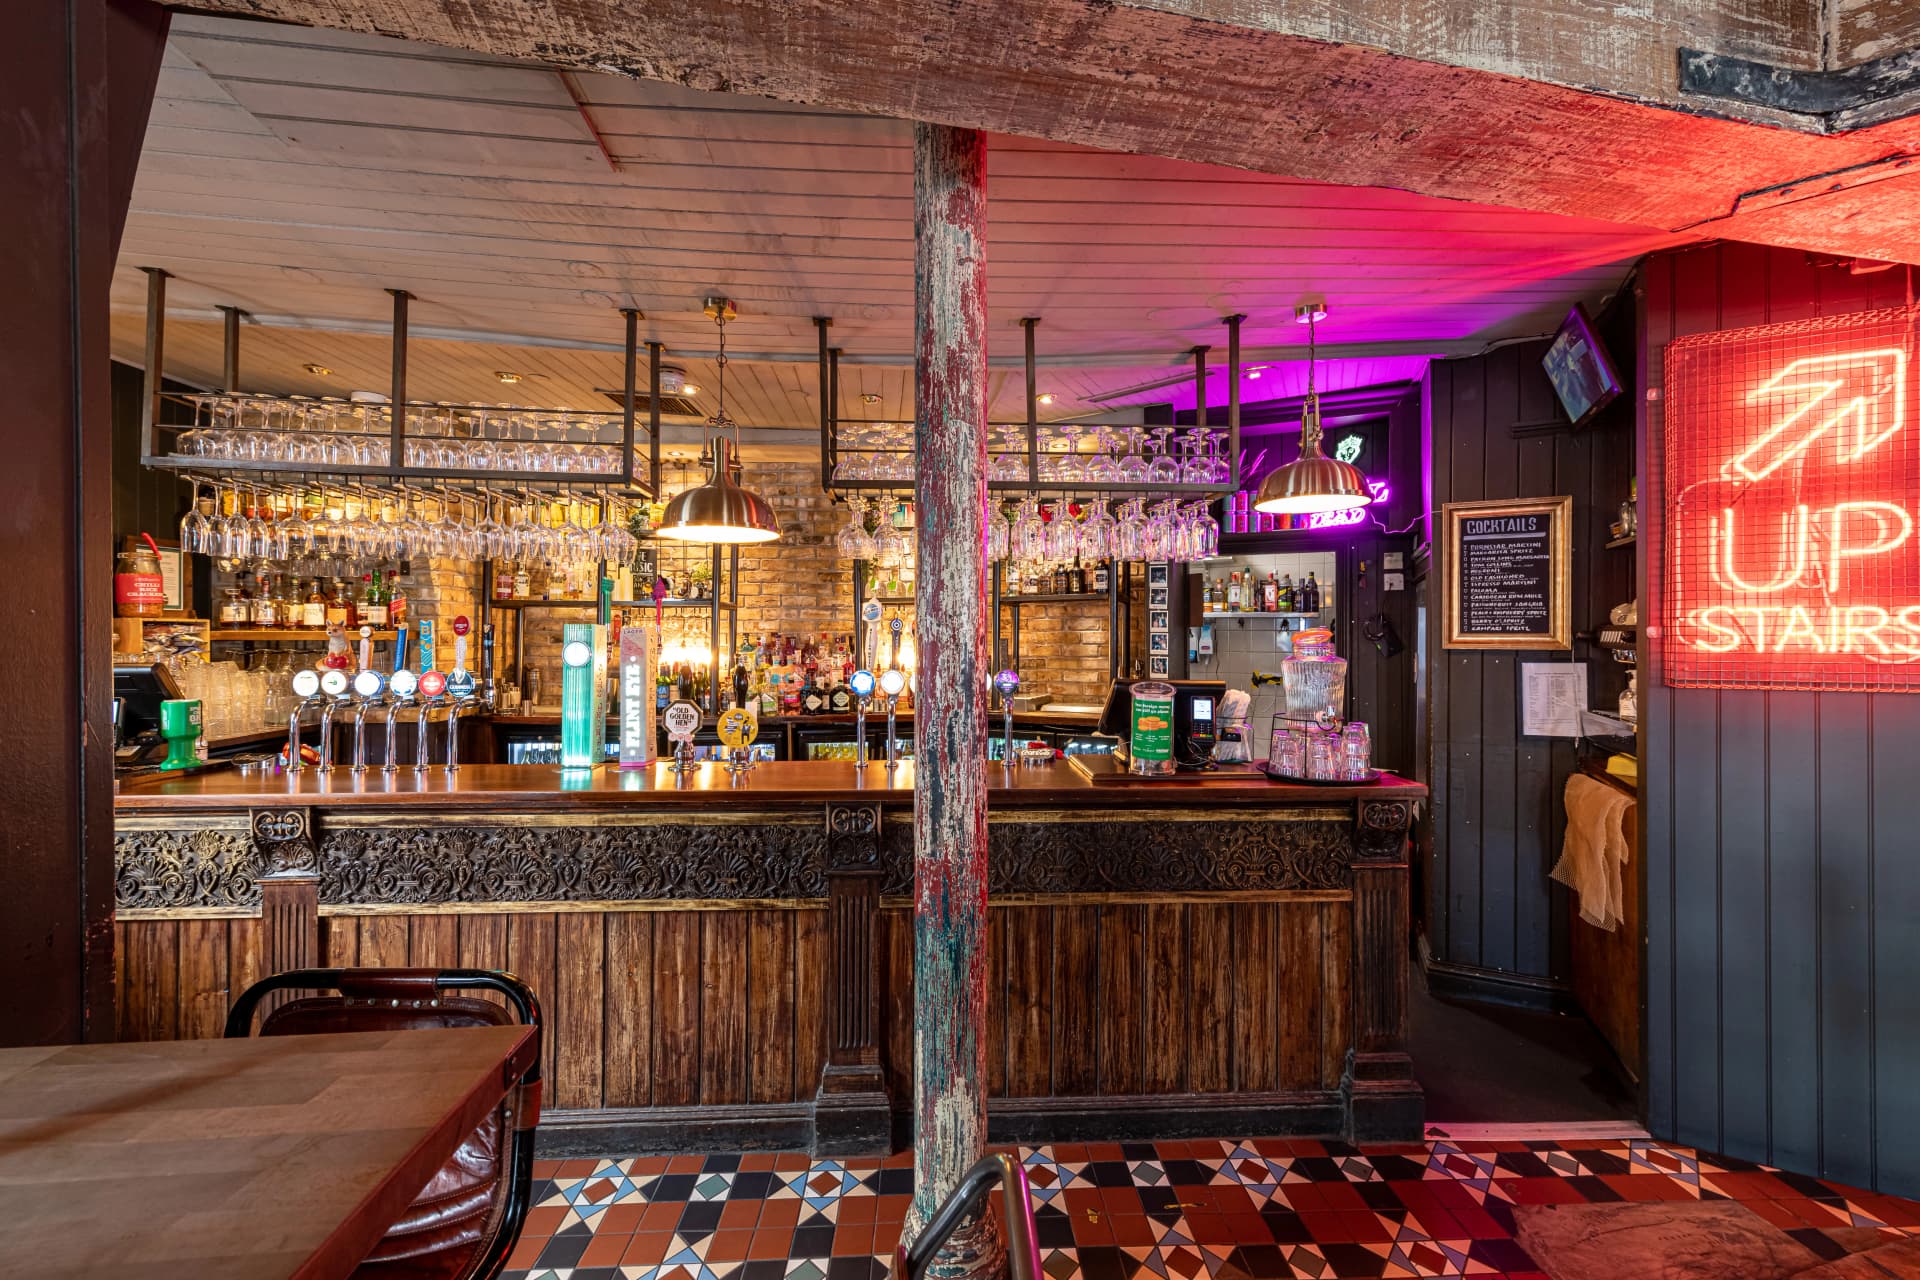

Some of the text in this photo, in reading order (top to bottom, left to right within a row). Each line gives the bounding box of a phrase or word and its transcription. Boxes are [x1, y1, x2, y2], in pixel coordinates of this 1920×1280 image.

[1466, 517, 1537, 534] COCKTAILS
[1724, 501, 1913, 593] UP
[1694, 606, 1920, 655] STAIRS
[625, 664, 641, 697] EYE
[625, 699, 641, 748] FLINT
